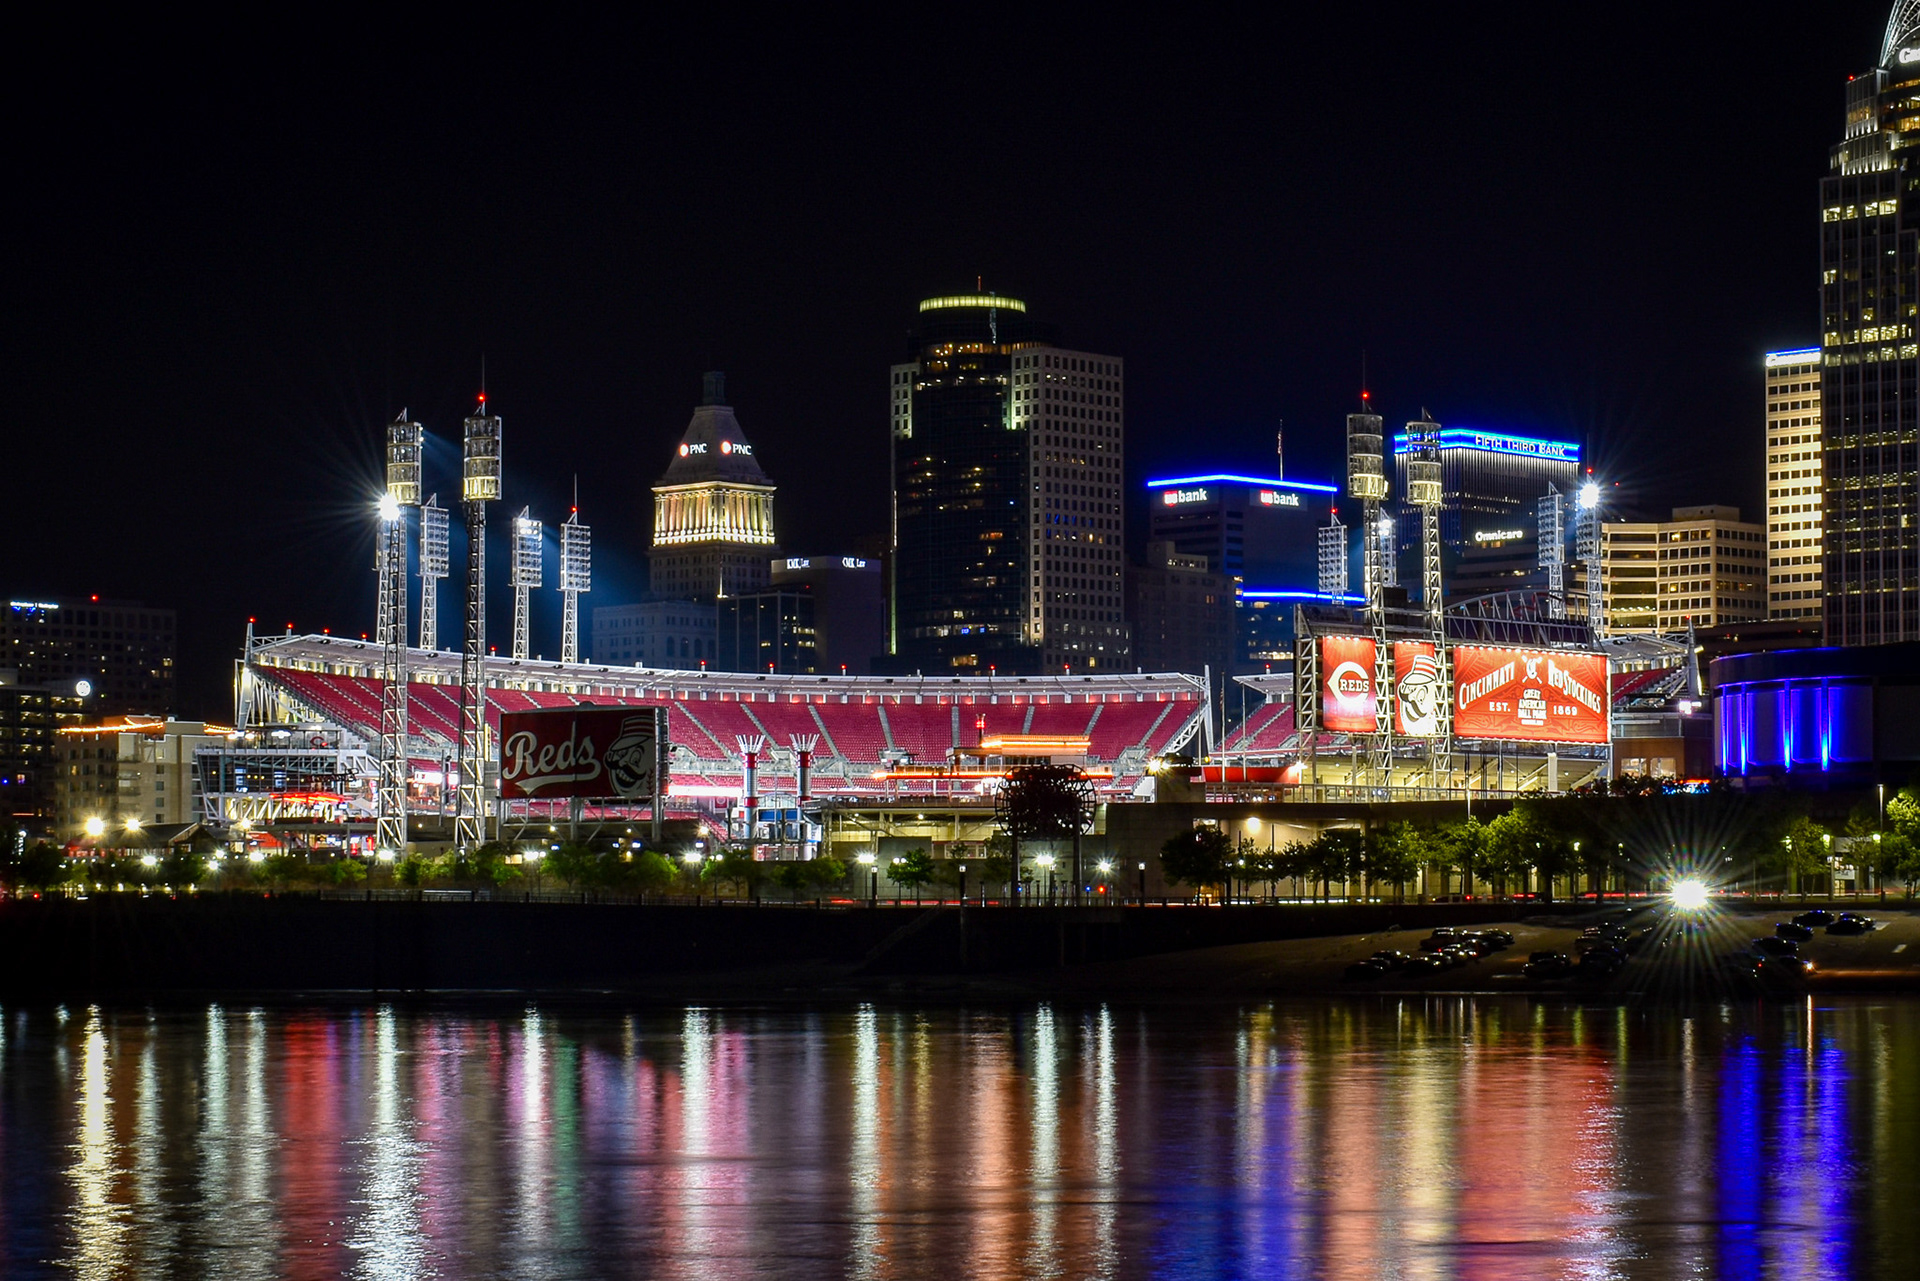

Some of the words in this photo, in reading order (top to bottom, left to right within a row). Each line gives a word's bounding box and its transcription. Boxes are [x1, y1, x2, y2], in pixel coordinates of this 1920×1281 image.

[689, 443, 708, 454] PNC
[732, 443, 752, 455] PNC
[1475, 434, 1502, 448] FIFTH
[1507, 440, 1536, 453] THIRD
[1538, 442, 1565, 457] BANK
[1340, 679, 1370, 692] REDS
[1459, 661, 1515, 710] CINCINNATI
[1489, 702, 1511, 712] EST.
[1553, 705, 1578, 716] 1869
[502, 721, 601, 795] Reds
